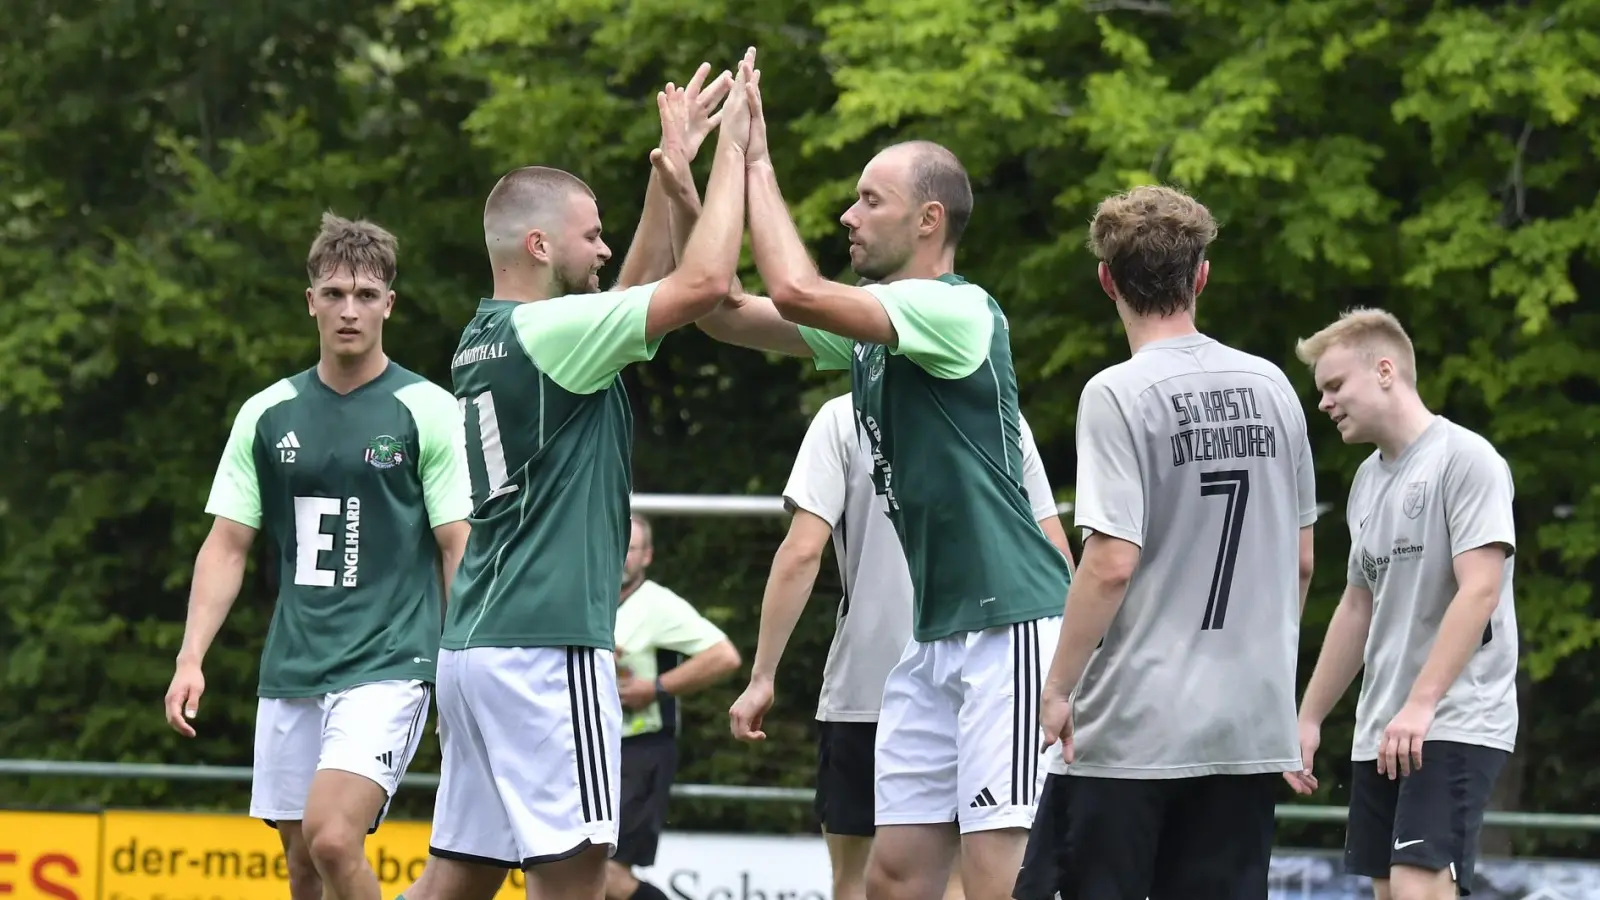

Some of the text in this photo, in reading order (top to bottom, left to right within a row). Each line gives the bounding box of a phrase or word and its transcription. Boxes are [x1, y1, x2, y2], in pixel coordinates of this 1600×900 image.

[1172, 388, 1261, 426] SG KASTL
[280, 450, 296, 463] 12
[1170, 425, 1276, 466] UTZENHOFEN
[294, 496, 341, 587] E
[342, 496, 361, 587] ENGLHARD
[1200, 470, 1250, 631] 7
